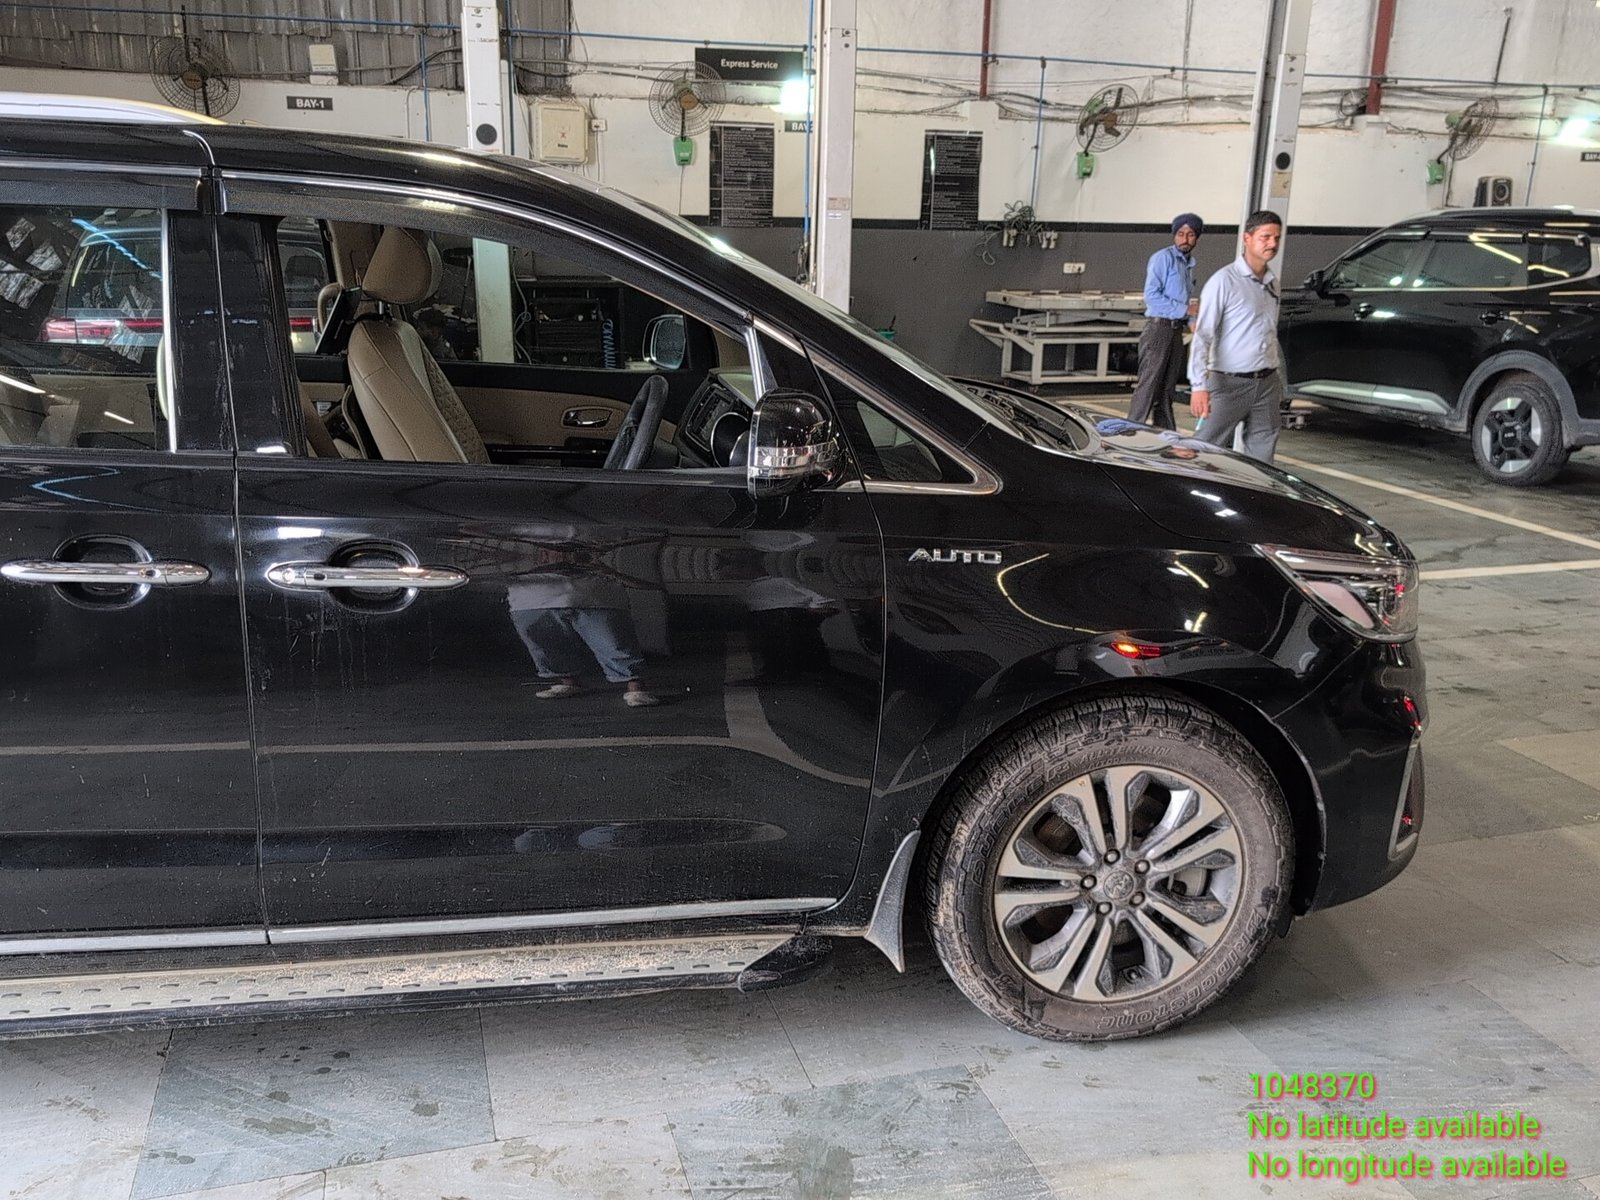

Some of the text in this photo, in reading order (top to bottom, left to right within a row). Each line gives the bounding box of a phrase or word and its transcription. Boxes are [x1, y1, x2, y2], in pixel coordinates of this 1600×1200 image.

[720, 58, 778, 69] Express Service
[295, 98, 325, 109] BAY-1
[908, 547, 1002, 564] AUTO
[1097, 907, 1264, 1030] BRIDGESTONE
